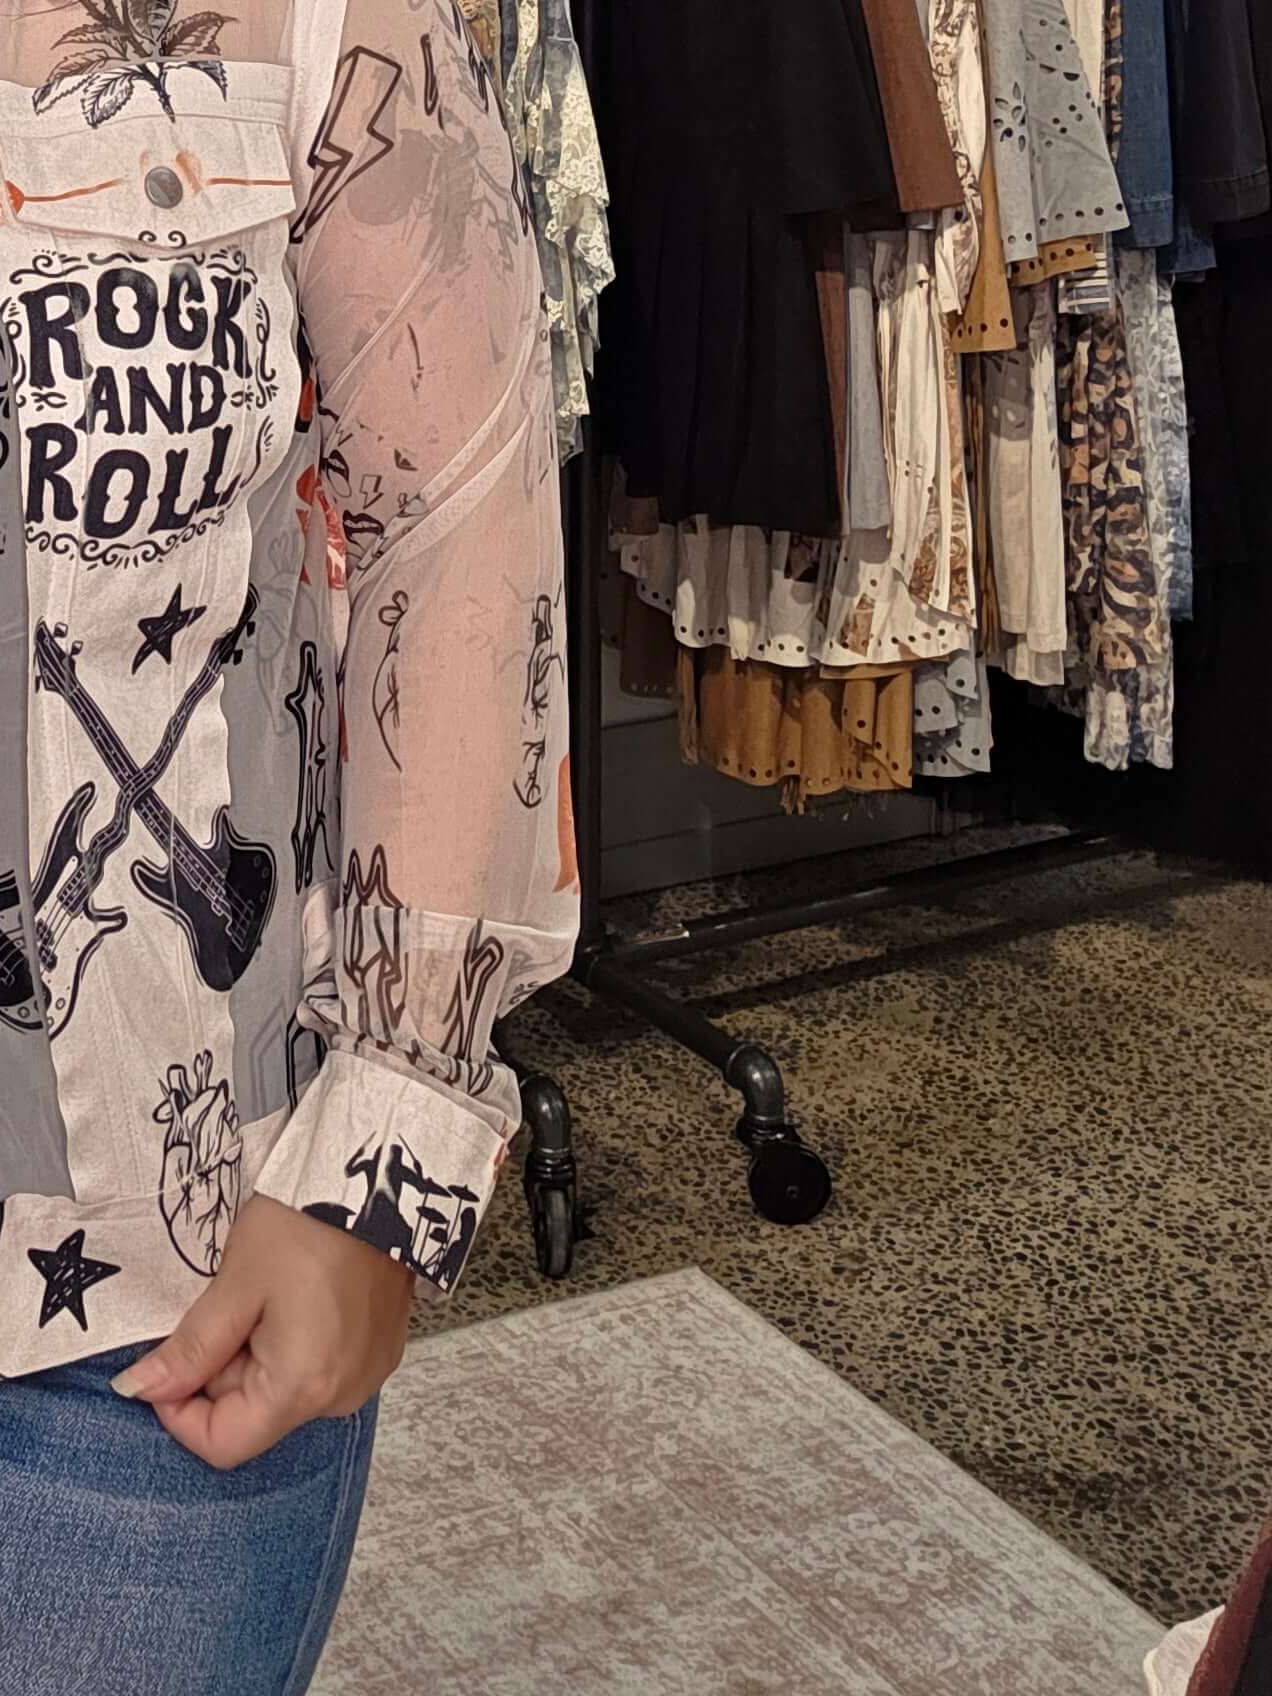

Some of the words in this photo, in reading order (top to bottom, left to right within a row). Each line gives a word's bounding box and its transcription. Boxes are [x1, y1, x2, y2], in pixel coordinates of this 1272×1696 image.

[19, 262, 252, 388] ROCK
[74, 362, 226, 434] AND
[25, 422, 242, 539] ROLL
